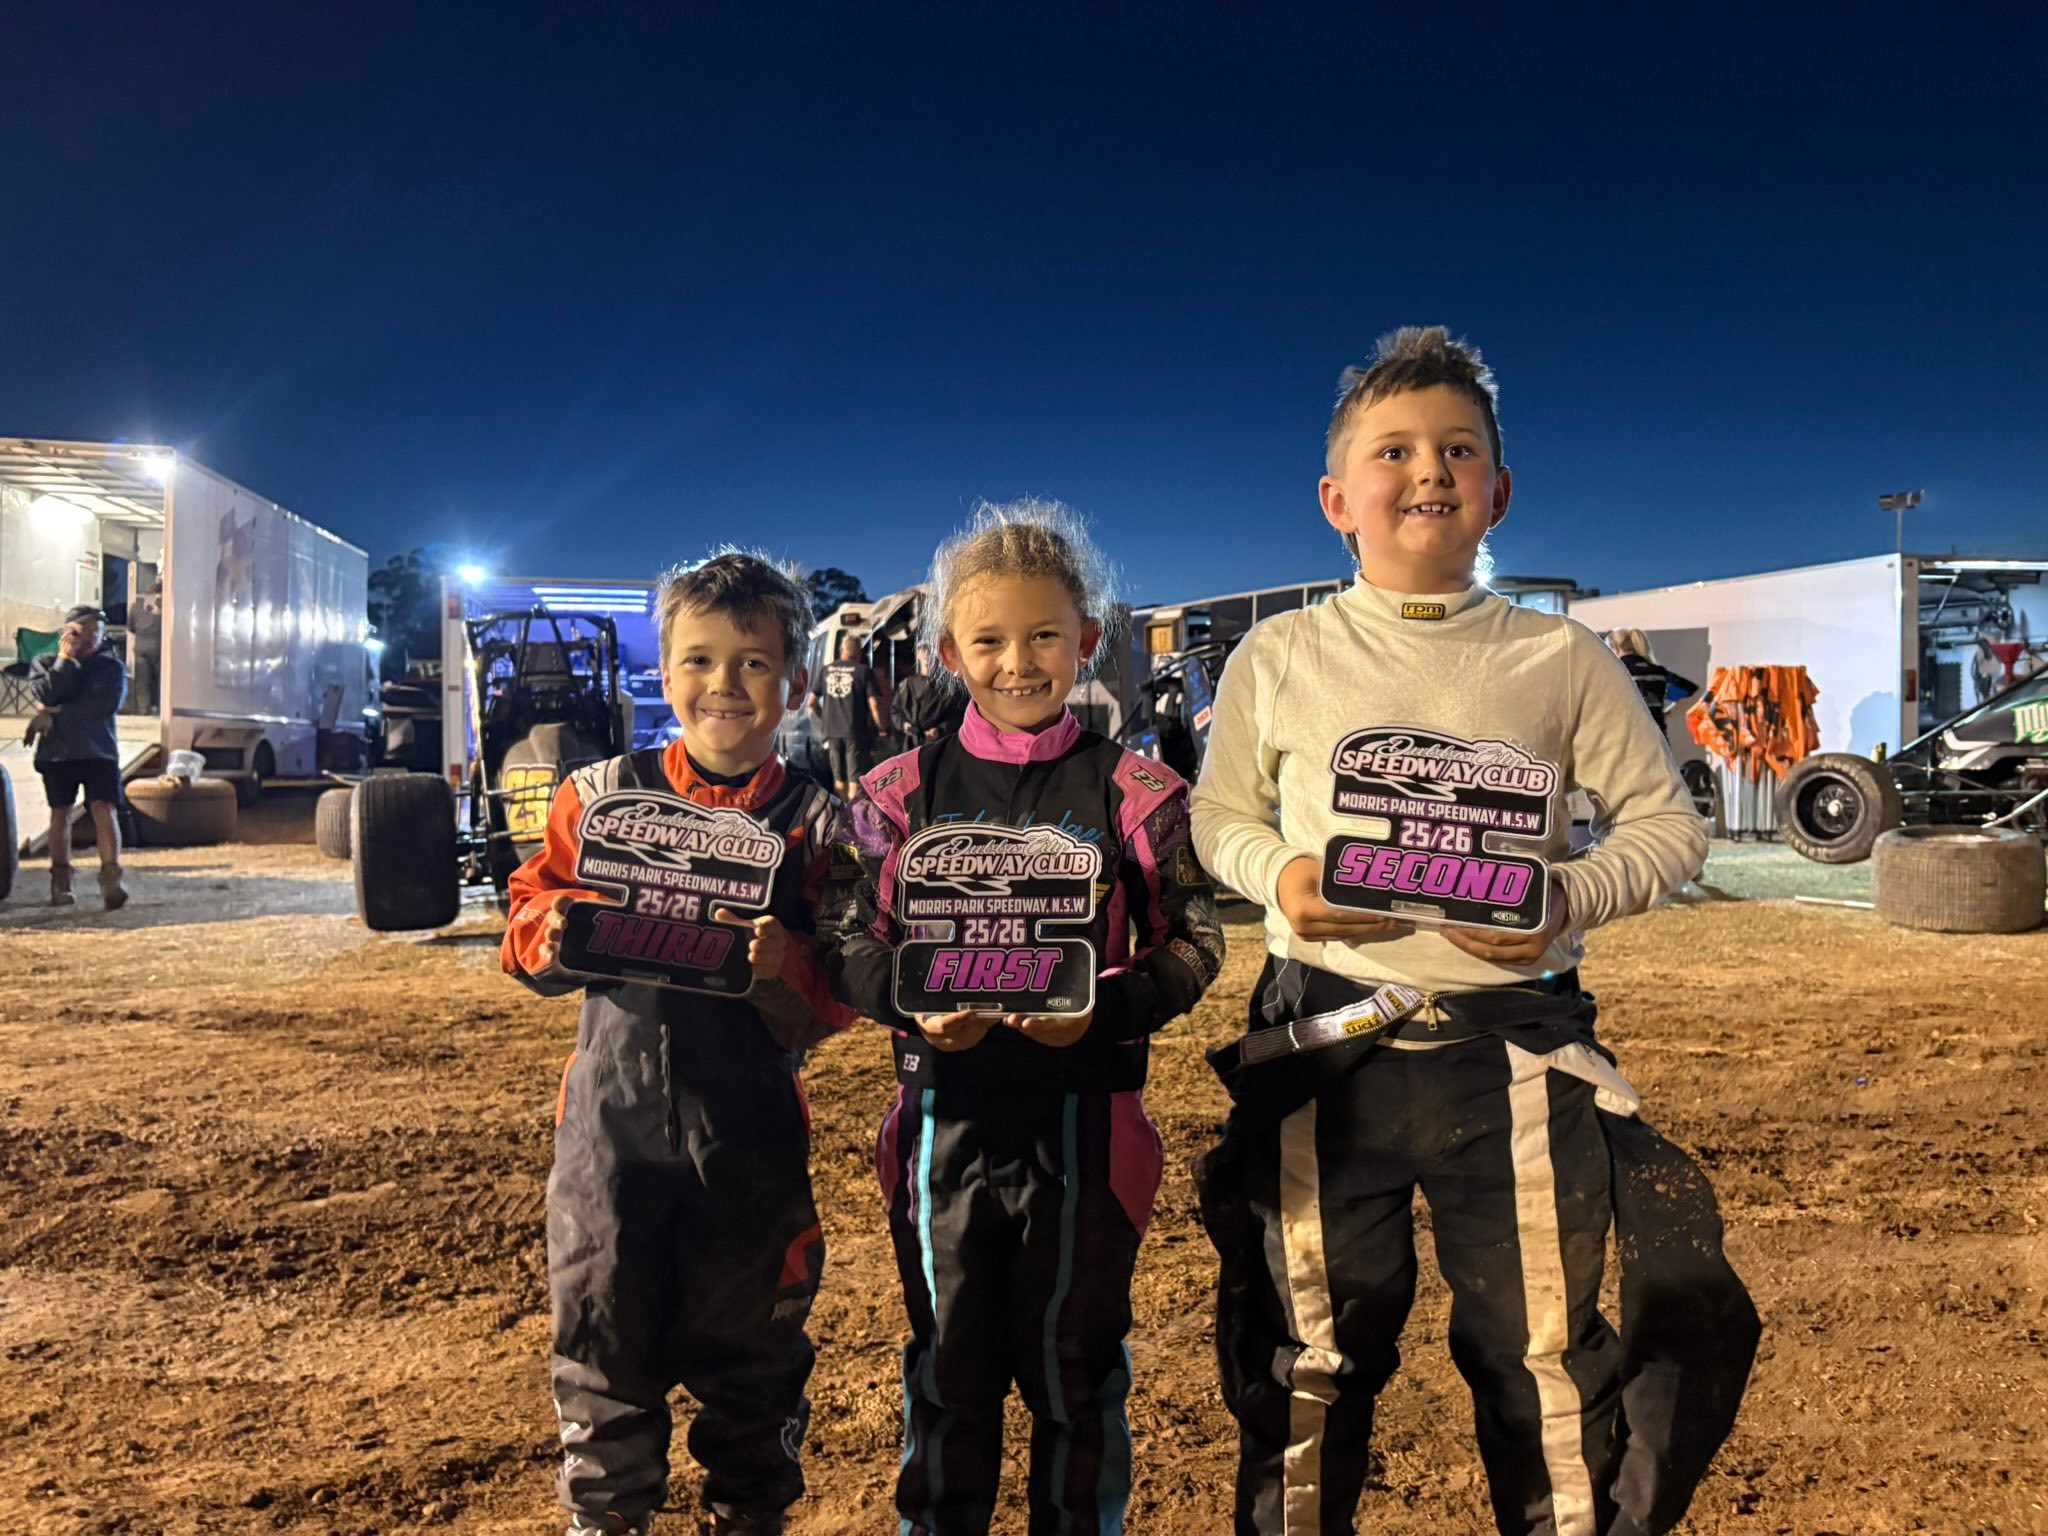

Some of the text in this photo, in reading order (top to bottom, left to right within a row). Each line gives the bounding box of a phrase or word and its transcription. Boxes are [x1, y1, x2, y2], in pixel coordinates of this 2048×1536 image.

[1340, 751, 1547, 791] SPEEDWAY CLUB
[1338, 792, 1387, 812] MORRIS
[1391, 798, 1425, 817] PARK
[1502, 811, 1541, 829] N.S.W
[588, 814, 774, 861] SPEEDWAY CLUB
[1400, 821, 1472, 852] 25/26
[584, 858, 629, 880] MORRIS
[630, 864, 663, 885] PARK
[728, 880, 762, 899] N.S.W
[908, 853, 1089, 877] SPEEDWAY CLUB
[1334, 844, 1532, 905] SECOND
[635, 888, 699, 921] 25/26
[909, 898, 951, 915] MORRIS
[954, 899, 985, 914] PARK
[1050, 898, 1085, 914] N.S.W
[588, 910, 735, 970] THIRD
[963, 919, 1026, 945] 25/26
[924, 947, 1062, 992] FIRST
